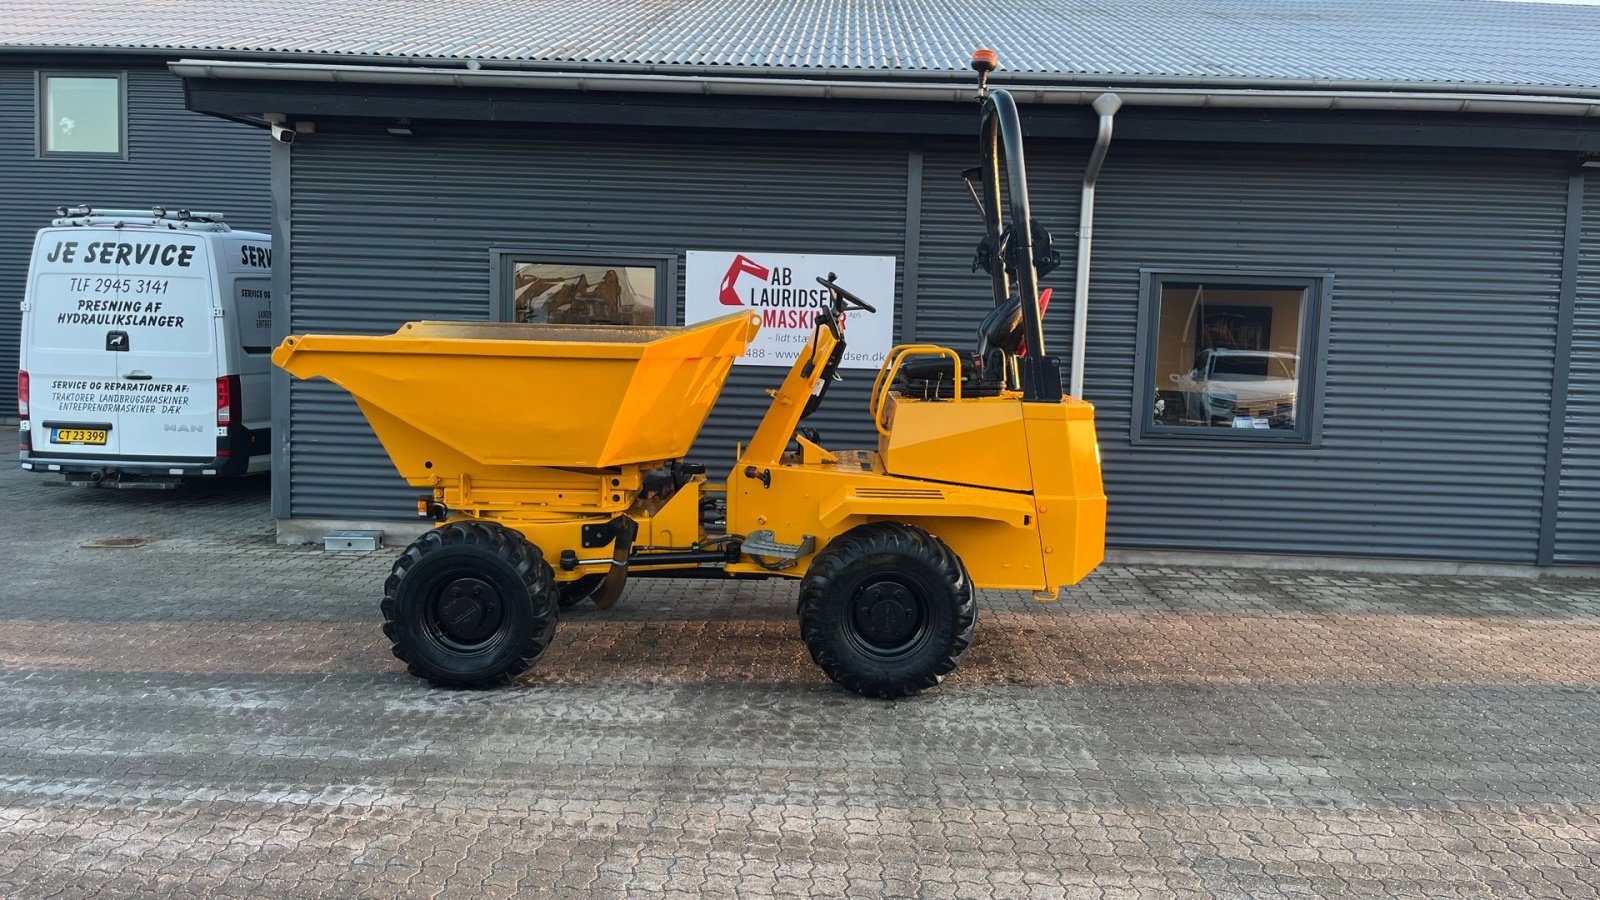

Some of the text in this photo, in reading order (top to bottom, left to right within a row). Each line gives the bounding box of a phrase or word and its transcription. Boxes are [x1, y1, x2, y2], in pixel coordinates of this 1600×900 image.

[47, 241, 196, 267] JE SERVICE
[241, 244, 272, 269] SERV
[771, 267, 792, 286] AB
[70, 278, 169, 294] TLF 2945 3141
[77, 300, 163, 313] PRESNING AF
[57, 313, 185, 328] HYDRAULIKSLANGER
[763, 309, 847, 330] MASKIR
[793, 334, 809, 343] stæ
[745, 348, 765, 358] 488
[52, 381, 190, 393] SERVICE OG REPARATIONER AF:
[52, 392, 189, 405] TRAKTORER LANDBRUGSMASKINER
[59, 402, 181, 414] ENTREPRENØRMASKINER DÆK
[58, 430, 105, 441] CT 23 399
